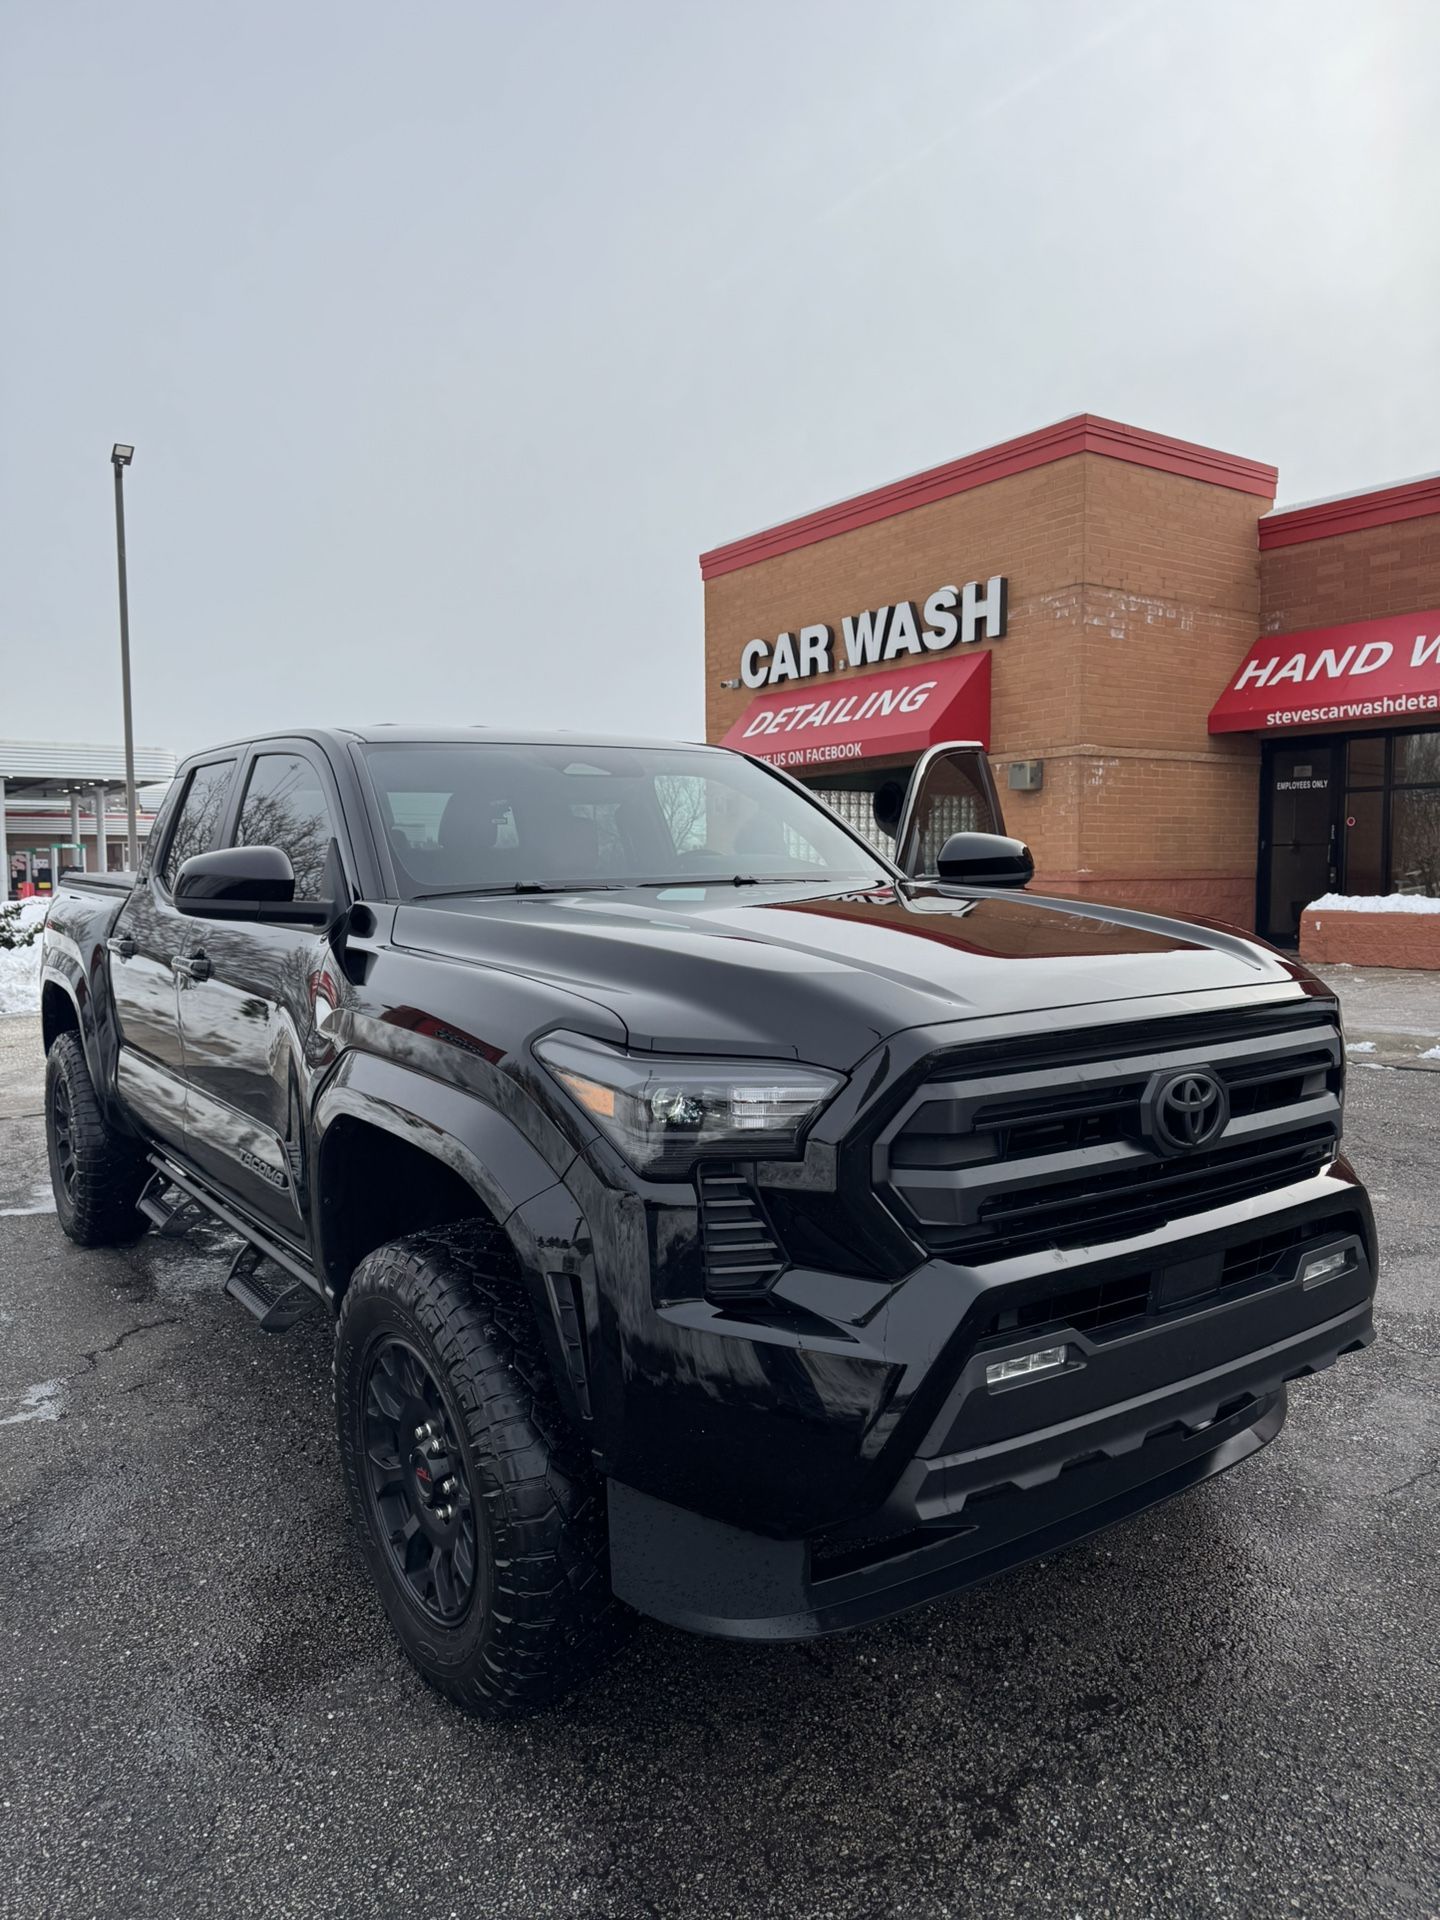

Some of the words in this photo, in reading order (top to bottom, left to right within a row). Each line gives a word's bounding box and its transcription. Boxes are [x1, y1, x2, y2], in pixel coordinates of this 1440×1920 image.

[740, 624, 832, 689] CAR
[842, 576, 1007, 668] WASH
[1233, 641, 1394, 690] HAND
[742, 681, 937, 738] DETAILING
[1266, 693, 1440, 726] stevescarwashdeta
[773, 752, 786, 766] US
[788, 750, 803, 764] ON
[806, 742, 863, 763] FACEBOOK
[1276, 781, 1311, 790] EMPLOYEES
[1311, 779, 1328, 789] ONLY
[239, 1148, 284, 1186] TACOMA
